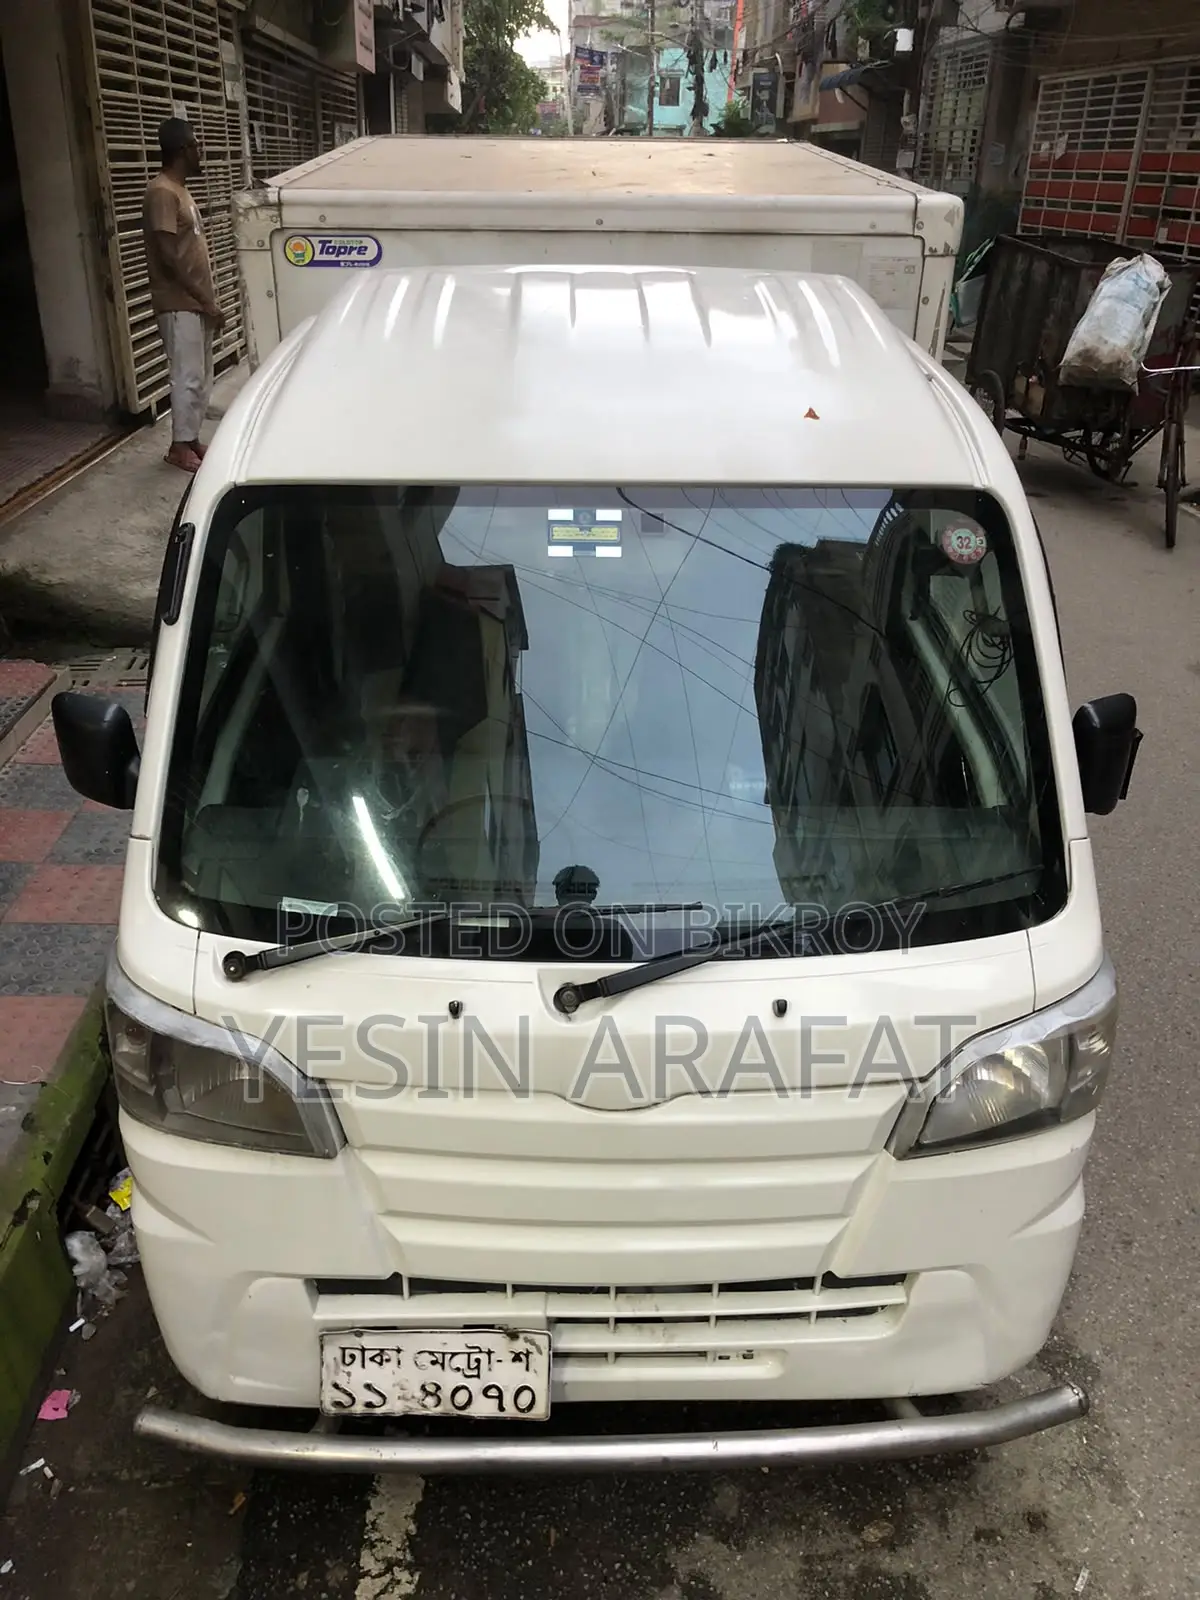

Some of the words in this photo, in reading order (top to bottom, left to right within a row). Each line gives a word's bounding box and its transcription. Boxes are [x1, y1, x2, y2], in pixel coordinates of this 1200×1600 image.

[318, 239, 368, 258] Topre
[956, 535, 972, 550] 32
[338, 1345, 404, 1370] ঢাকা
